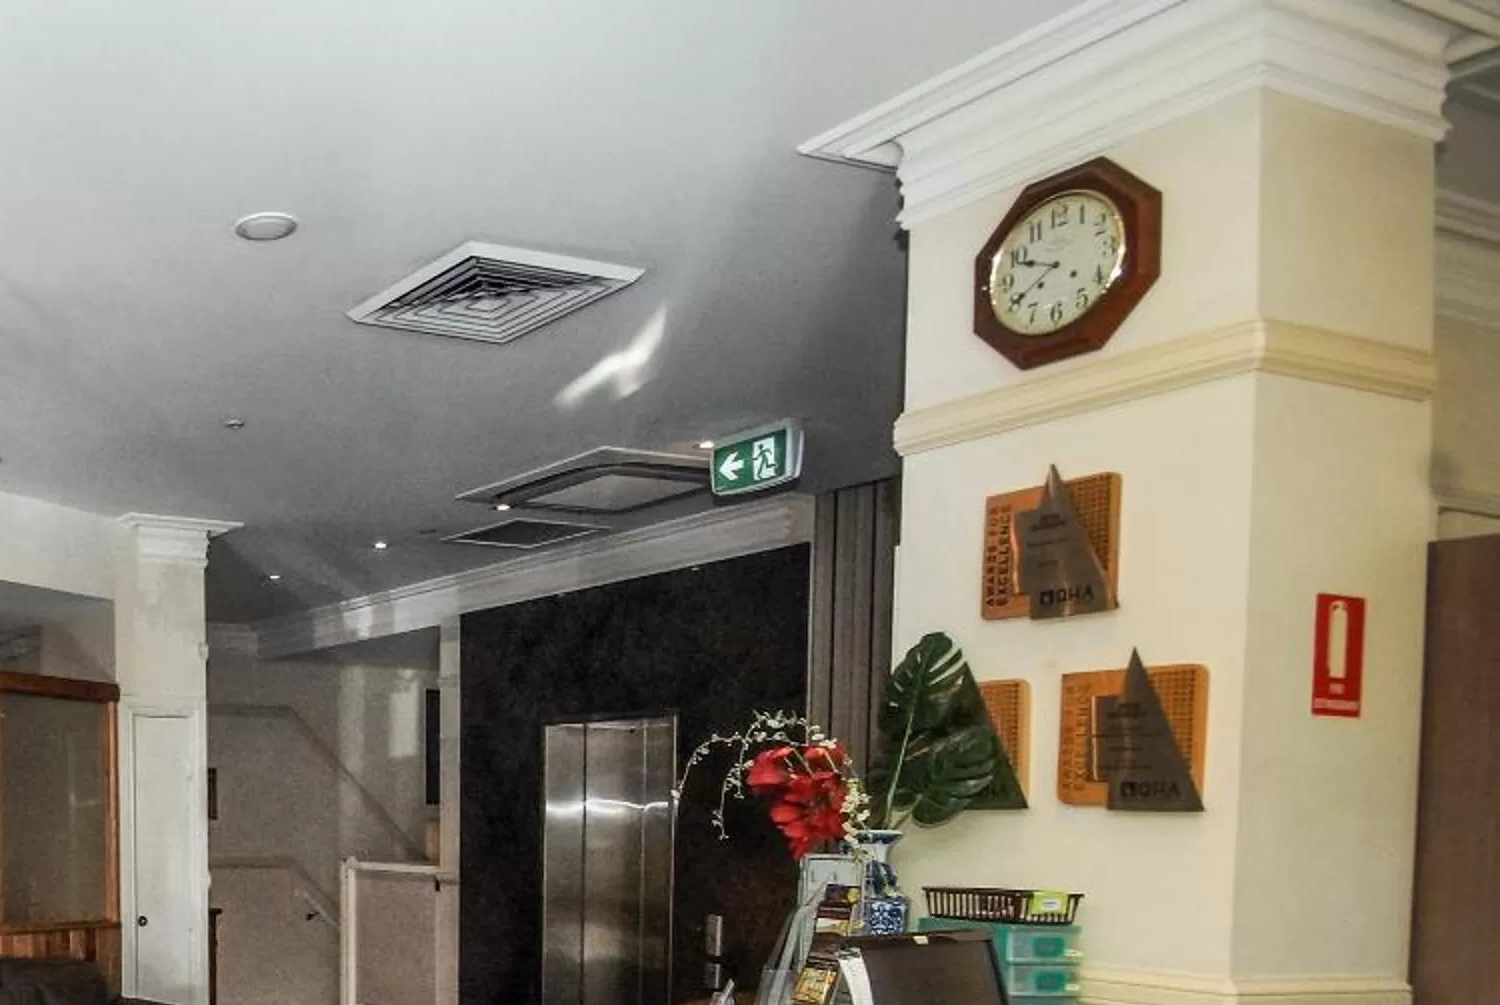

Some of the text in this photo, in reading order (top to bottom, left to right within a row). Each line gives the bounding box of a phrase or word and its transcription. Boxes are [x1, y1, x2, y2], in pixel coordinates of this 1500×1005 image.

[1050, 203, 1069, 230] 12
[1078, 203, 1086, 225] 1
[1093, 212, 1107, 237] 2
[1029, 219, 1043, 245] 11
[1010, 246, 1028, 269] 10
[1100, 235, 1116, 257] 3
[1001, 272, 1015, 293] 9
[1092, 263, 1104, 285] 4
[1075, 287, 1089, 309] 5
[1027, 301, 1039, 325] 7
[1050, 301, 1063, 324] 6
